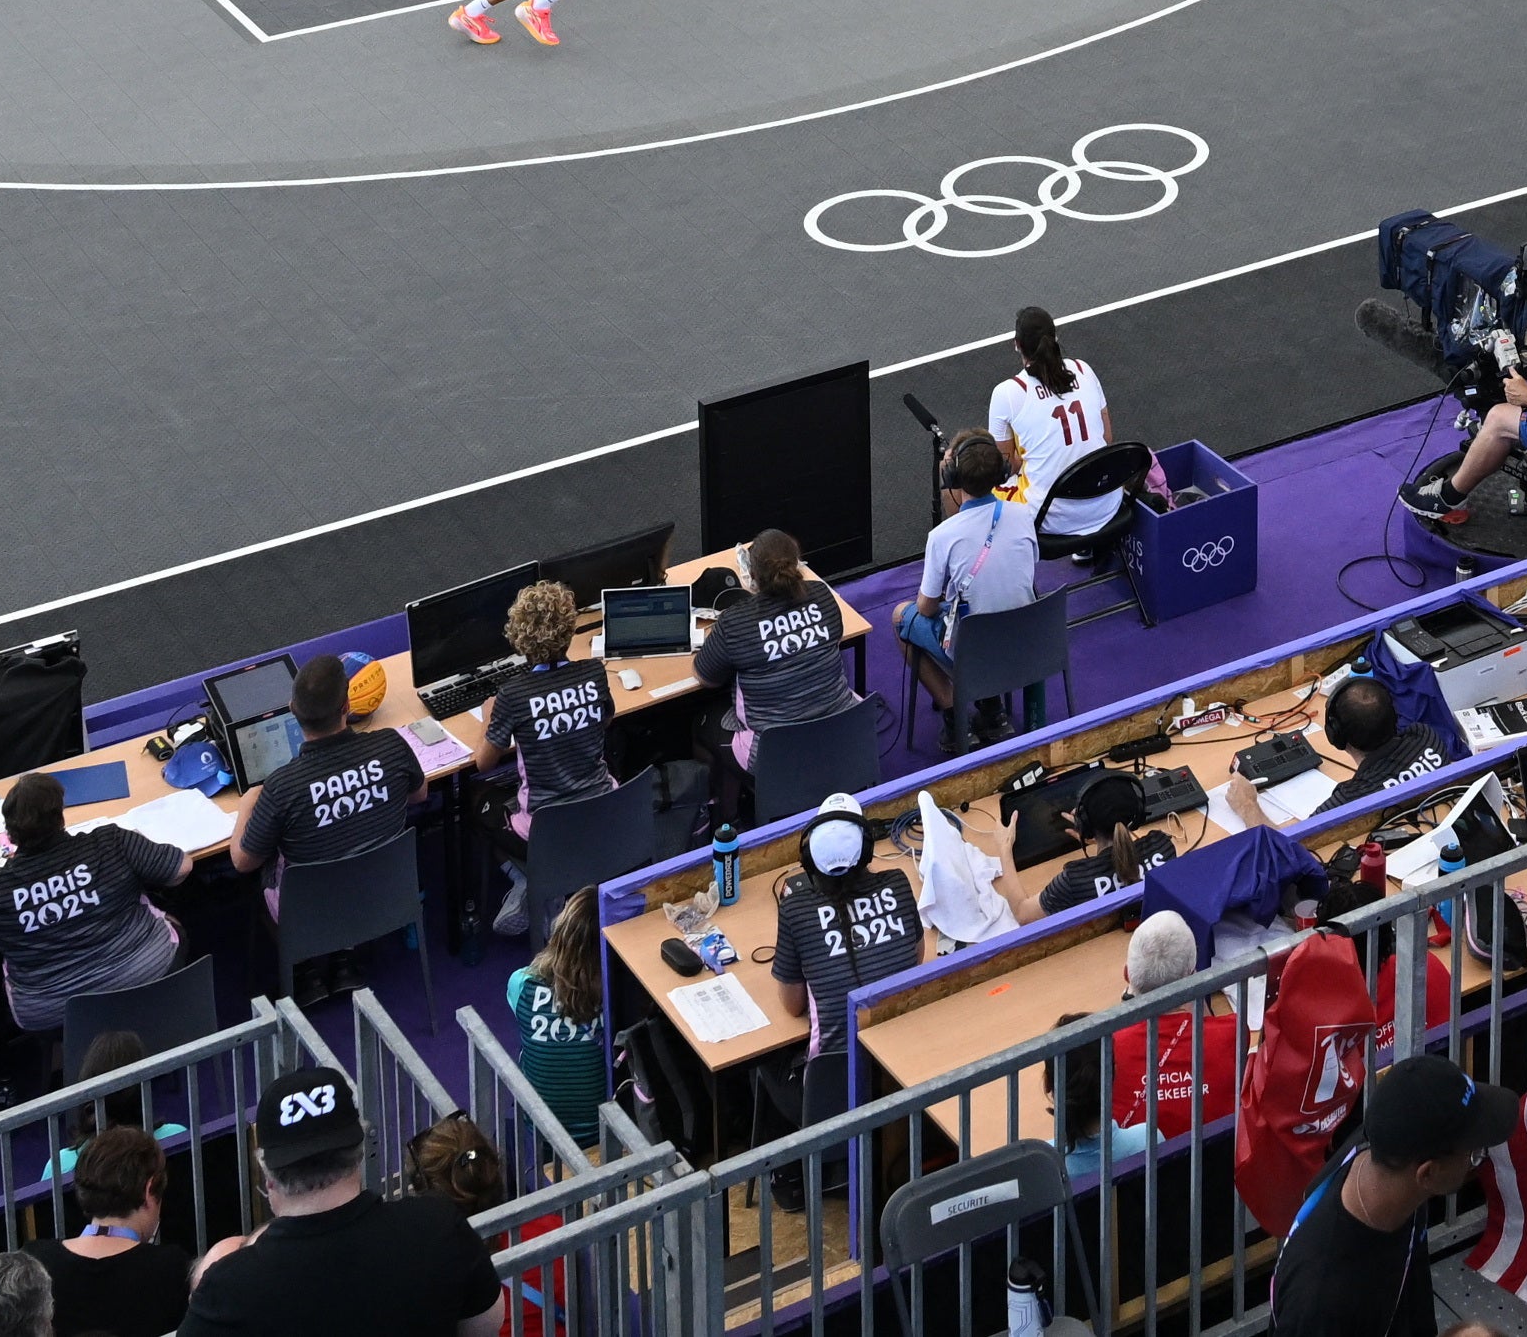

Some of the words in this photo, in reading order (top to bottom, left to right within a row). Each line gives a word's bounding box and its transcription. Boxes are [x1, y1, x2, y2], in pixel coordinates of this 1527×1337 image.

[1051, 399, 1090, 447] 11
[758, 603, 822, 642] PARIS
[763, 624, 830, 662] 2024
[528, 680, 599, 718] PARIS
[533, 704, 602, 741] 2024
[309, 759, 385, 805] PARIS
[314, 785, 389, 828] 2024
[12, 863, 93, 911] PARIS
[724, 853, 733, 899] POWERADE
[18, 889, 101, 934] 2024
[948, 1194, 989, 1217] SECURITE
